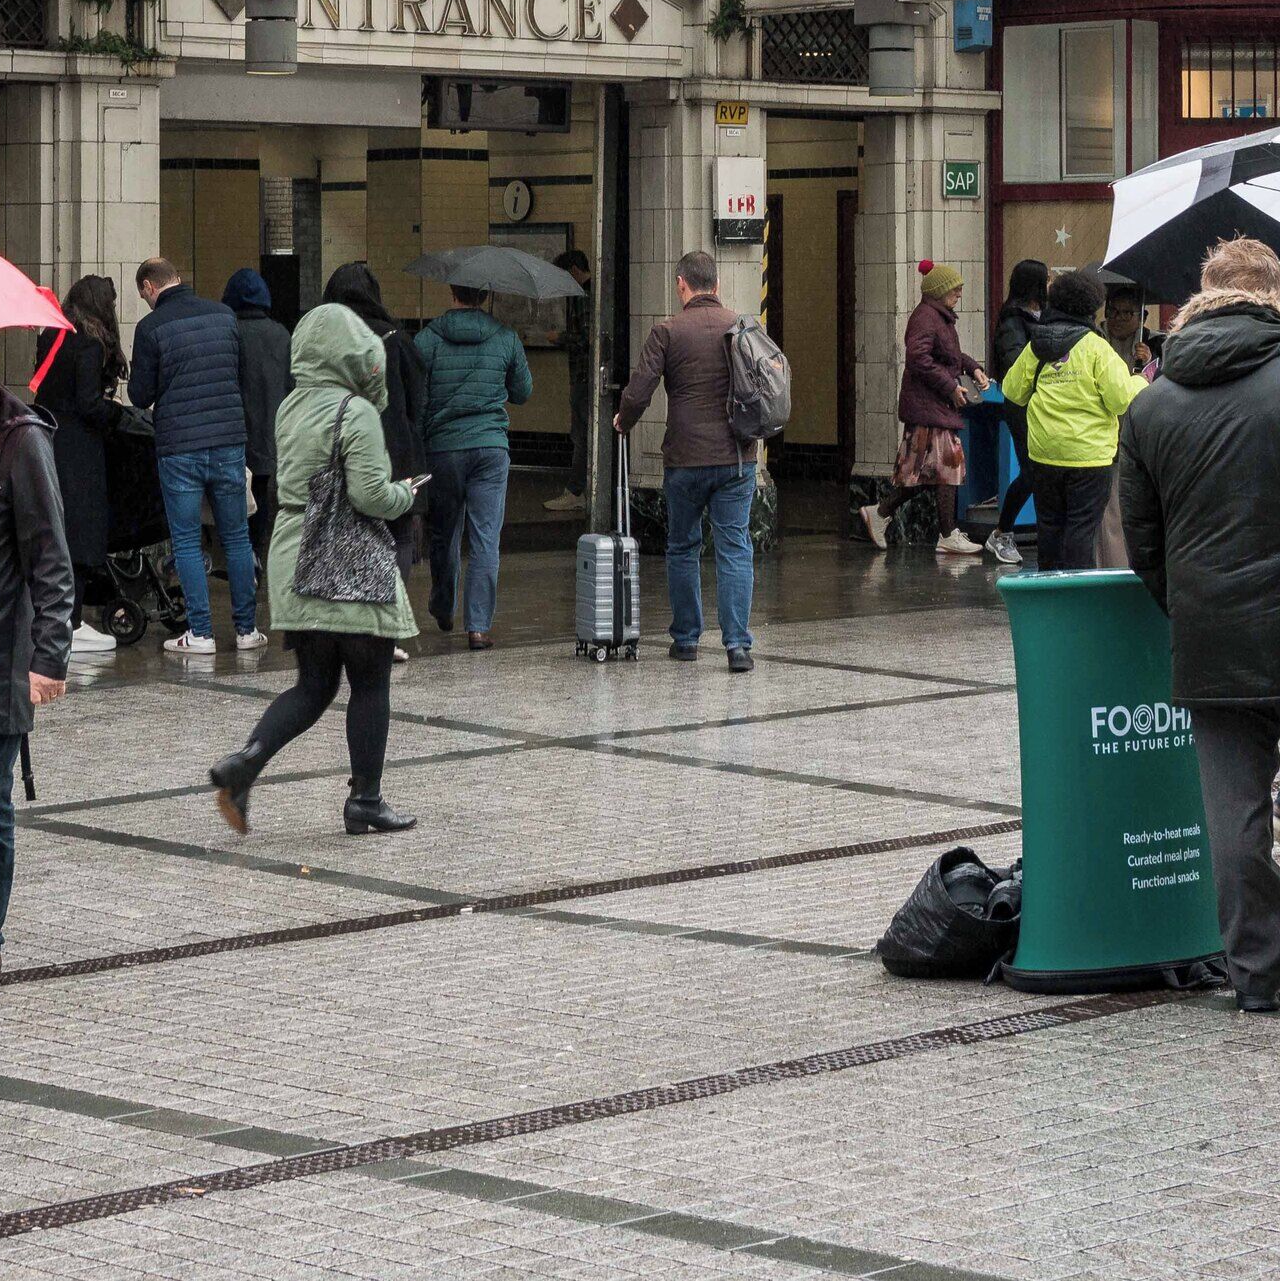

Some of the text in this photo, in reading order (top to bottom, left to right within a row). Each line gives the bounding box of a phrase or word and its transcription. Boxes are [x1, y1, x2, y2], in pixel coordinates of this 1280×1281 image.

[720, 106, 745, 120] RVP
[946, 171, 974, 190] SAP
[1093, 742, 1118, 754] THE
[1124, 736, 1169, 752] FUTURE
[1173, 735, 1185, 747] OF
[1123, 823, 1200, 844] Ready-to-heat meals
[1127, 847, 1199, 866] Curated meal plans
[1132, 870, 1199, 889] Functional snacks
